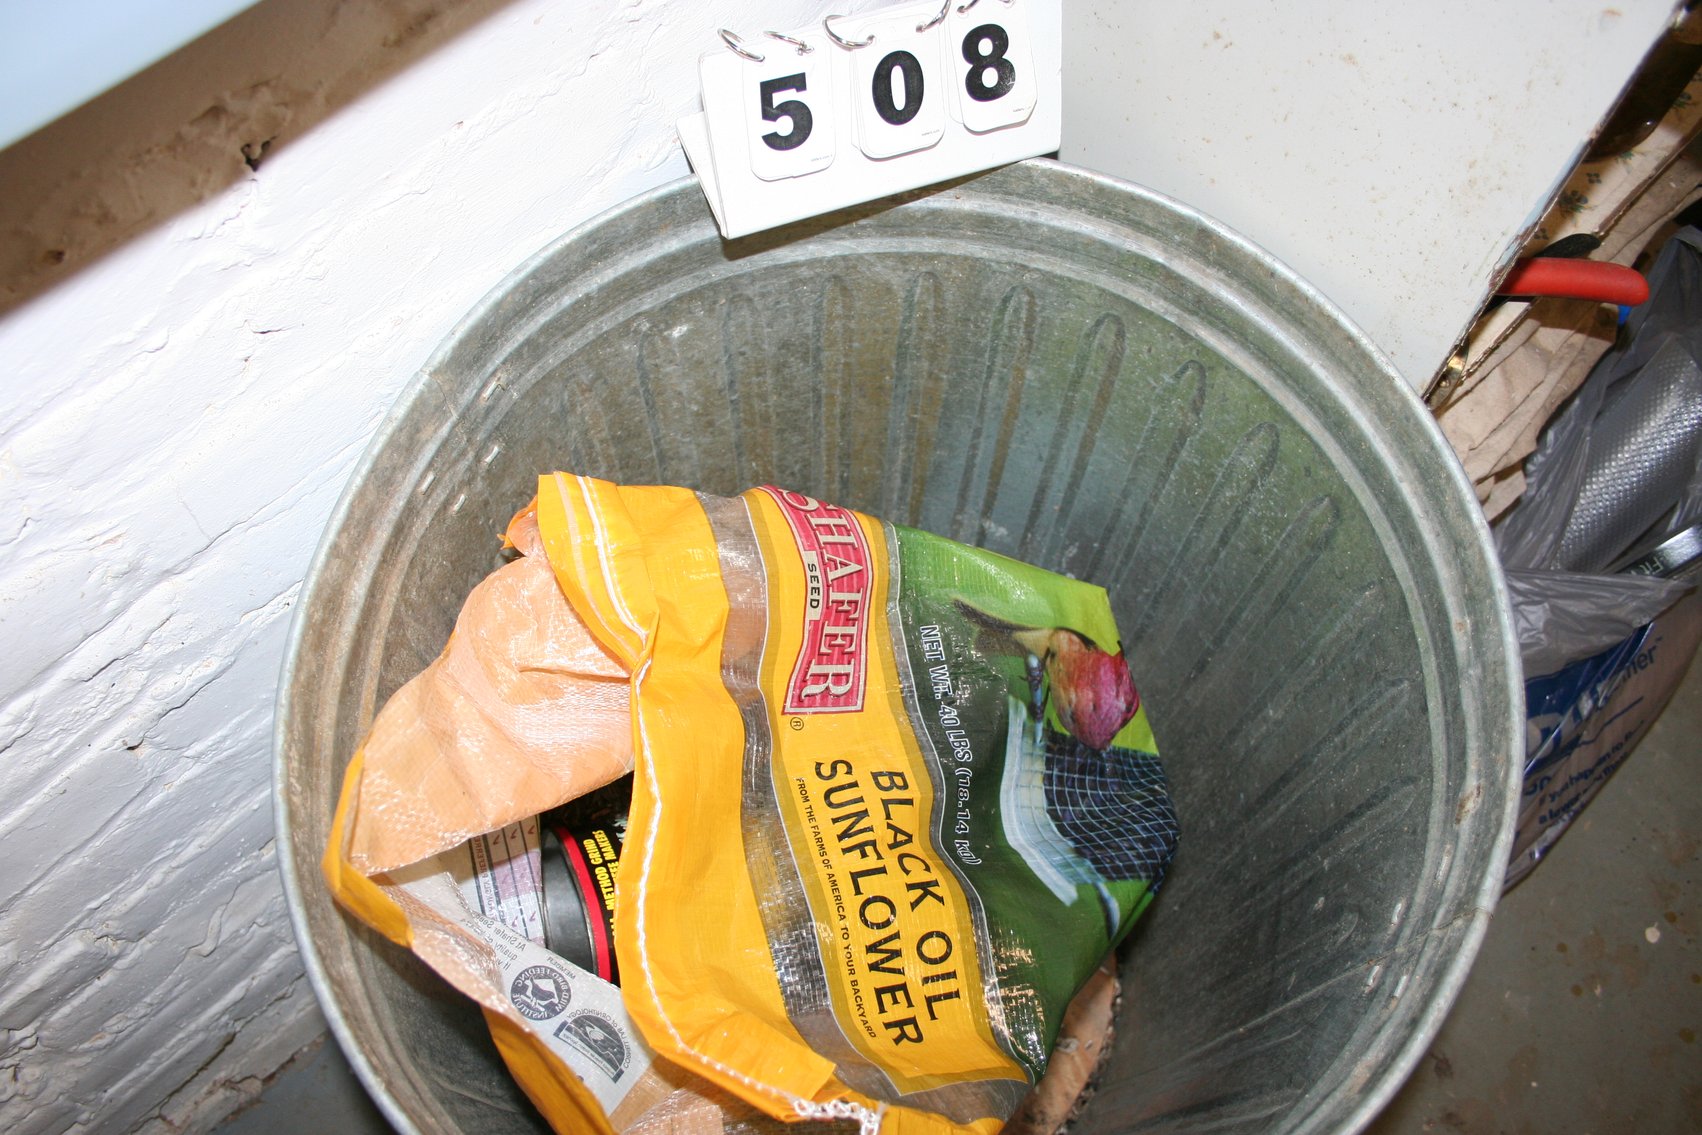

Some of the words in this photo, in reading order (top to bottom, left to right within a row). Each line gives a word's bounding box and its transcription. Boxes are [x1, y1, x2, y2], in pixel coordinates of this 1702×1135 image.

[807, 563, 821, 609] SEED
[920, 625, 945, 661] NET
[929, 665, 953, 699] WT.
[938, 704, 960, 727] 40
[946, 729, 973, 762] LBS
[795, 777, 810, 803] FROM
[955, 768, 973, 834] (18.14
[804, 805, 817, 823] THE
[583, 839, 603, 865] GRIND
[592, 830, 616, 860] MAKERS
[811, 825, 828, 858] FARMS
[822, 859, 832, 870] OF
[595, 866, 615, 911] METHOD
[814, 759, 924, 1046] SUNFLOWER
[827, 872, 846, 922] AMERICA
[870, 770, 945, 912] BLACK
[917, 930, 961, 1020] OIL
[841, 927, 849, 940] TO
[844, 943, 856, 976] YOUR
[850, 979, 876, 1038] BACKYARD
